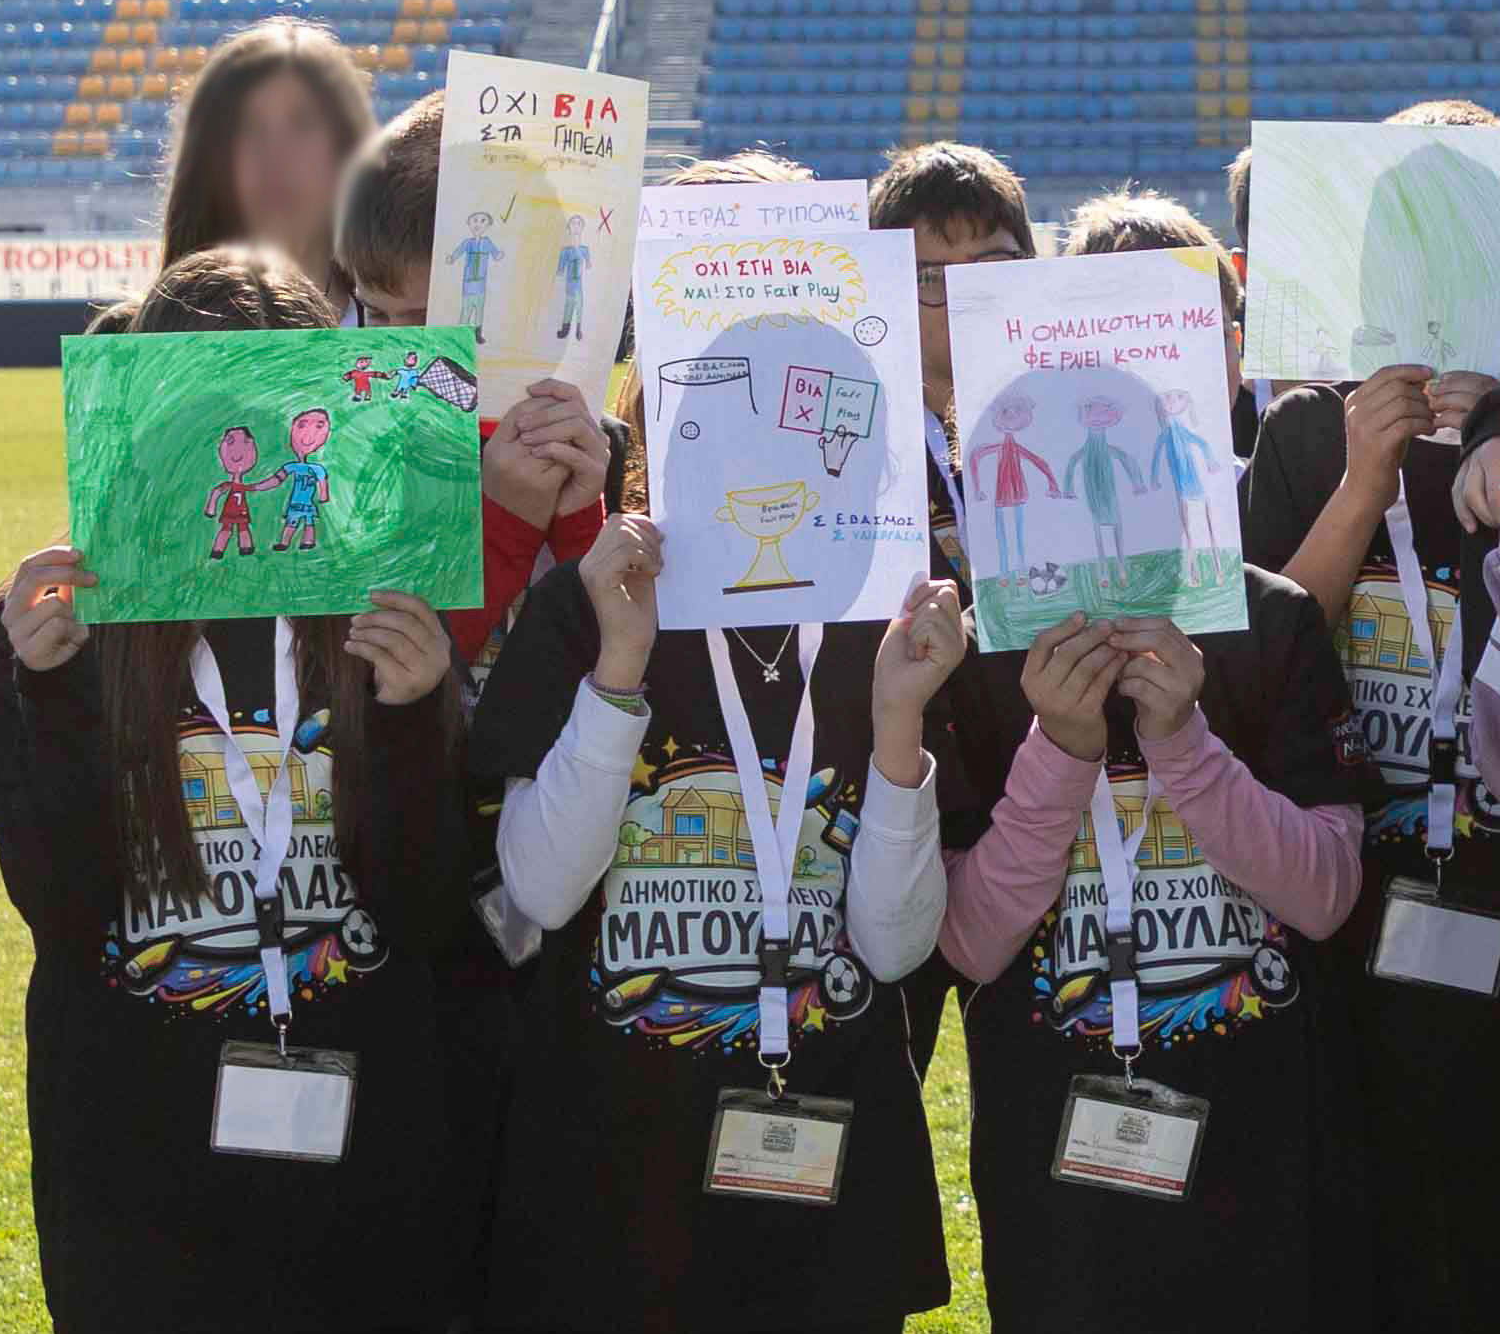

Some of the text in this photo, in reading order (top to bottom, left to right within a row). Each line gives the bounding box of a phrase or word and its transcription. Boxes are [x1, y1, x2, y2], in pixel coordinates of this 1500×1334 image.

[479, 86, 617, 129] ΟΧΙ ΒΙΑ
[481, 124, 613, 158] ΣΤΑ ΓΗΠΕΔΑ
[695, 259, 812, 276] ΟΧΙ ΣΤΗ ΒΙΑ
[724, 284, 755, 299] ΣΤΟ
[764, 283, 799, 298] Fair
[809, 282, 841, 303] Play
[1006, 318, 1022, 343] Η
[1182, 306, 1216, 328] ΜΑΣ
[1113, 343, 1181, 365] ΚΟΝΤΑ
[795, 378, 823, 398] ΒΙΑ
[619, 878, 737, 905] ΔΗΜΟΤΙΚΟ
